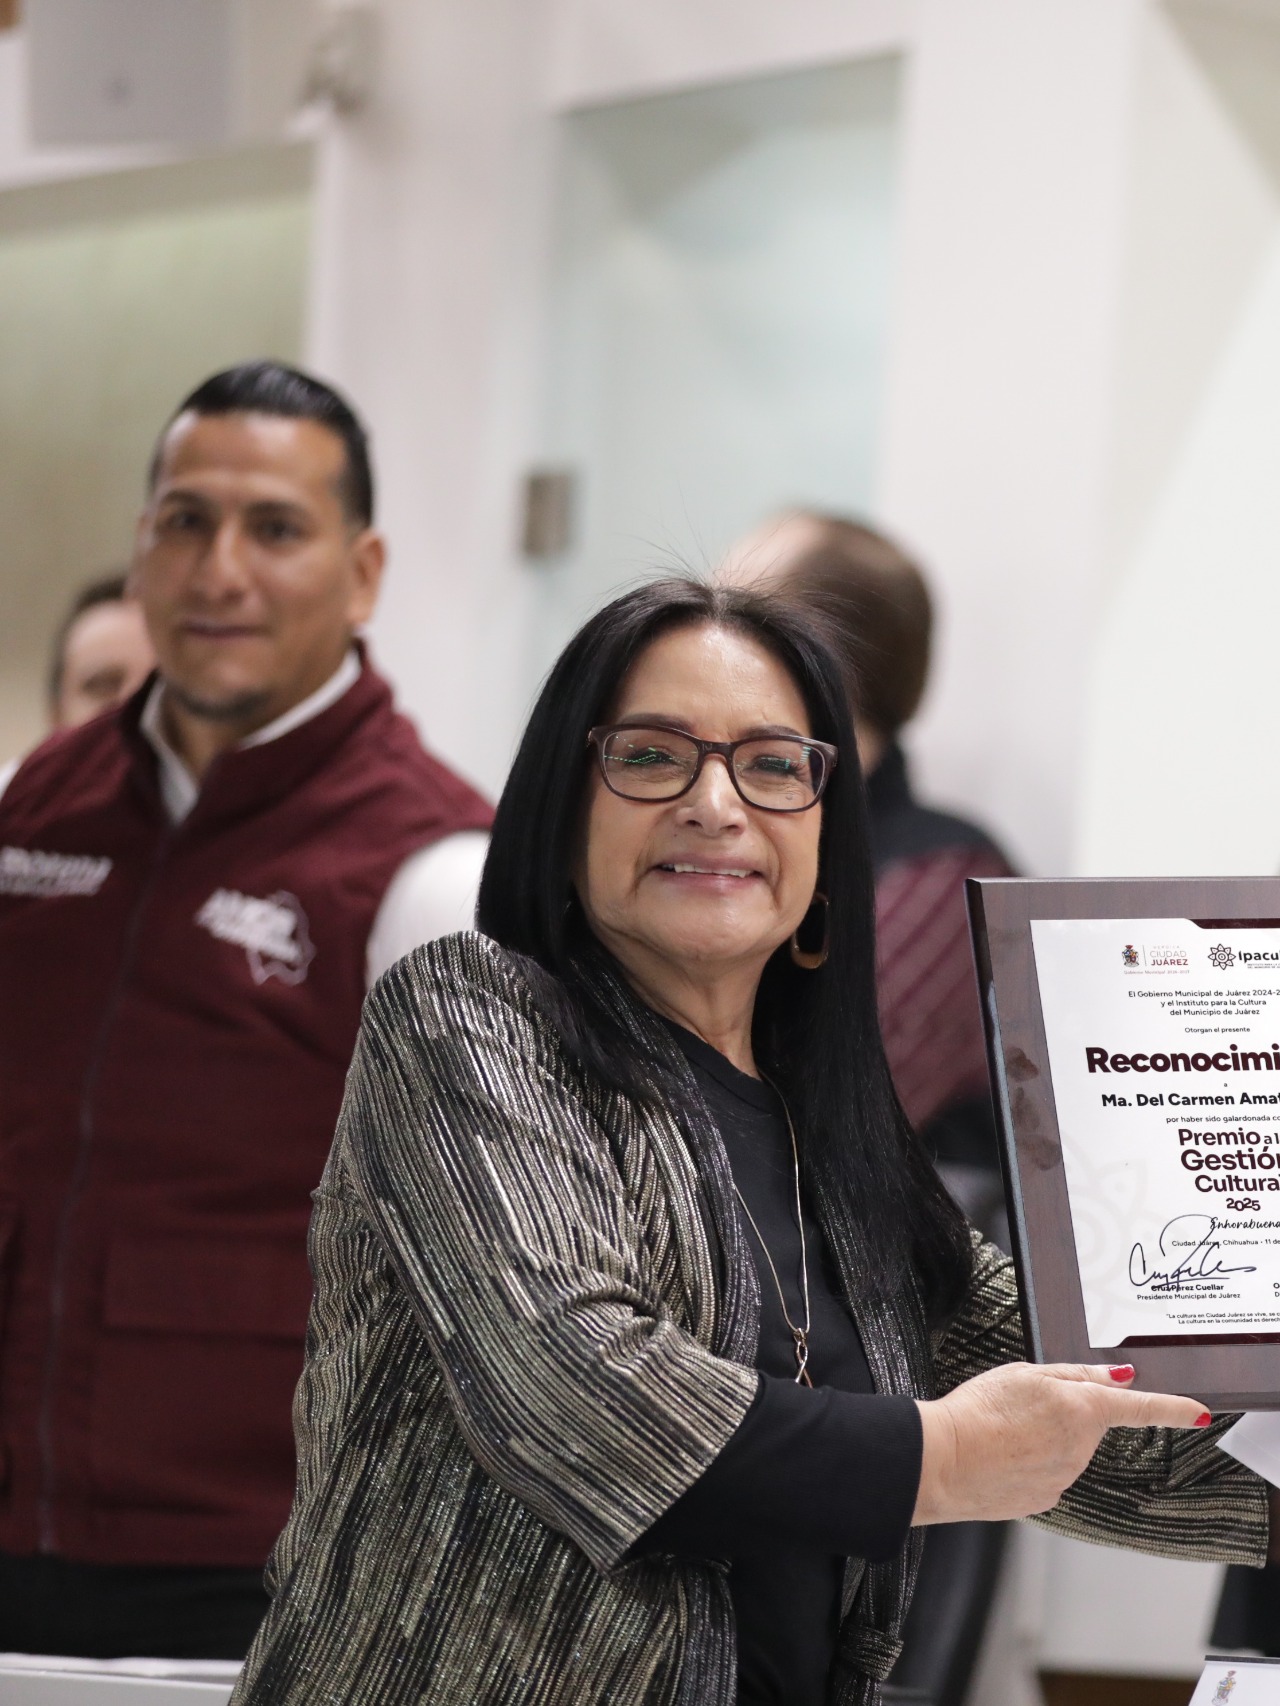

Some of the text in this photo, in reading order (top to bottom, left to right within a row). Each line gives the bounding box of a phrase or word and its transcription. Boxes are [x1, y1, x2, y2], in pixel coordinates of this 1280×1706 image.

[1150, 950, 1187, 958] CIUDAD
[1151, 957, 1188, 966] JUÁREZ
[1175, 989, 1212, 998] Municipal
[1101, 1093, 1132, 1107] Ma.
[1136, 1093, 1164, 1107] Del
[1168, 1093, 1235, 1107] Carmen
[1223, 1114, 1270, 1123] galardonada
[1178, 1127, 1261, 1147] Premio
[1263, 1134, 1273, 1145] a
[1226, 1197, 1261, 1211] 2025
[1172, 1239, 1196, 1247] Ciudad
[1223, 1238, 1259, 1246] Chihuahua
